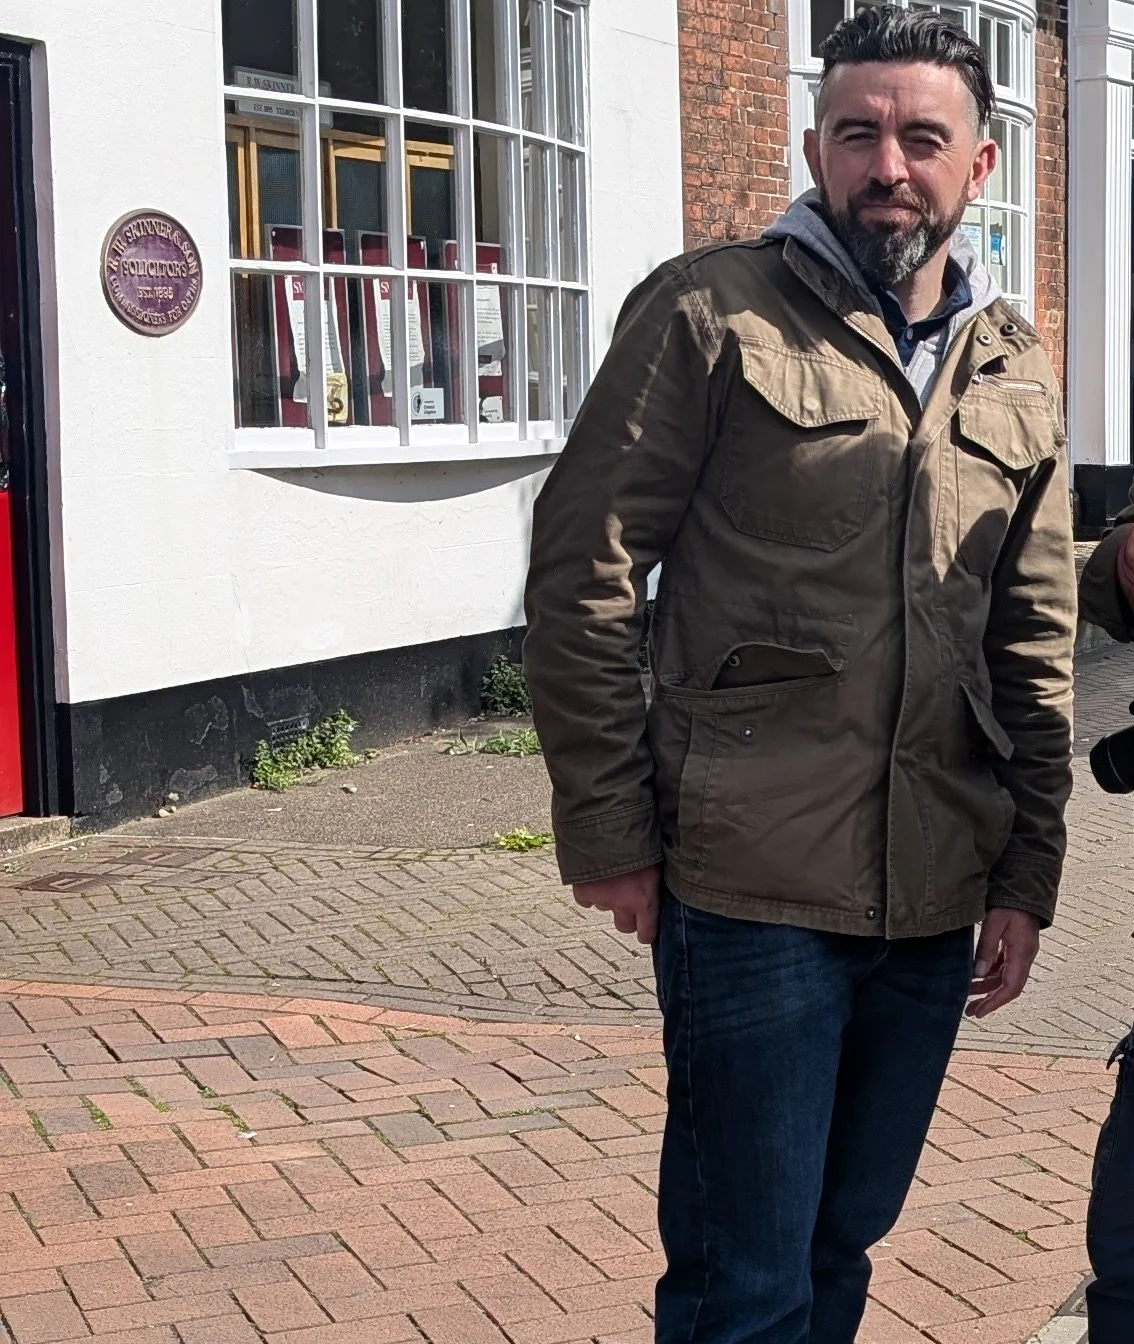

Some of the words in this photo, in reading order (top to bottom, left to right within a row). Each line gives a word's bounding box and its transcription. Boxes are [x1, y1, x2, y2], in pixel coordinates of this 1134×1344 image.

[121, 258, 188, 277] SOLICITORS
[124, 218, 172, 243] SKINNER
[171, 230, 182, 247] &
[181, 241, 199, 275] SON
[110, 275, 168, 325] COMMISSIONERS
[167, 306, 183, 322] FOR
